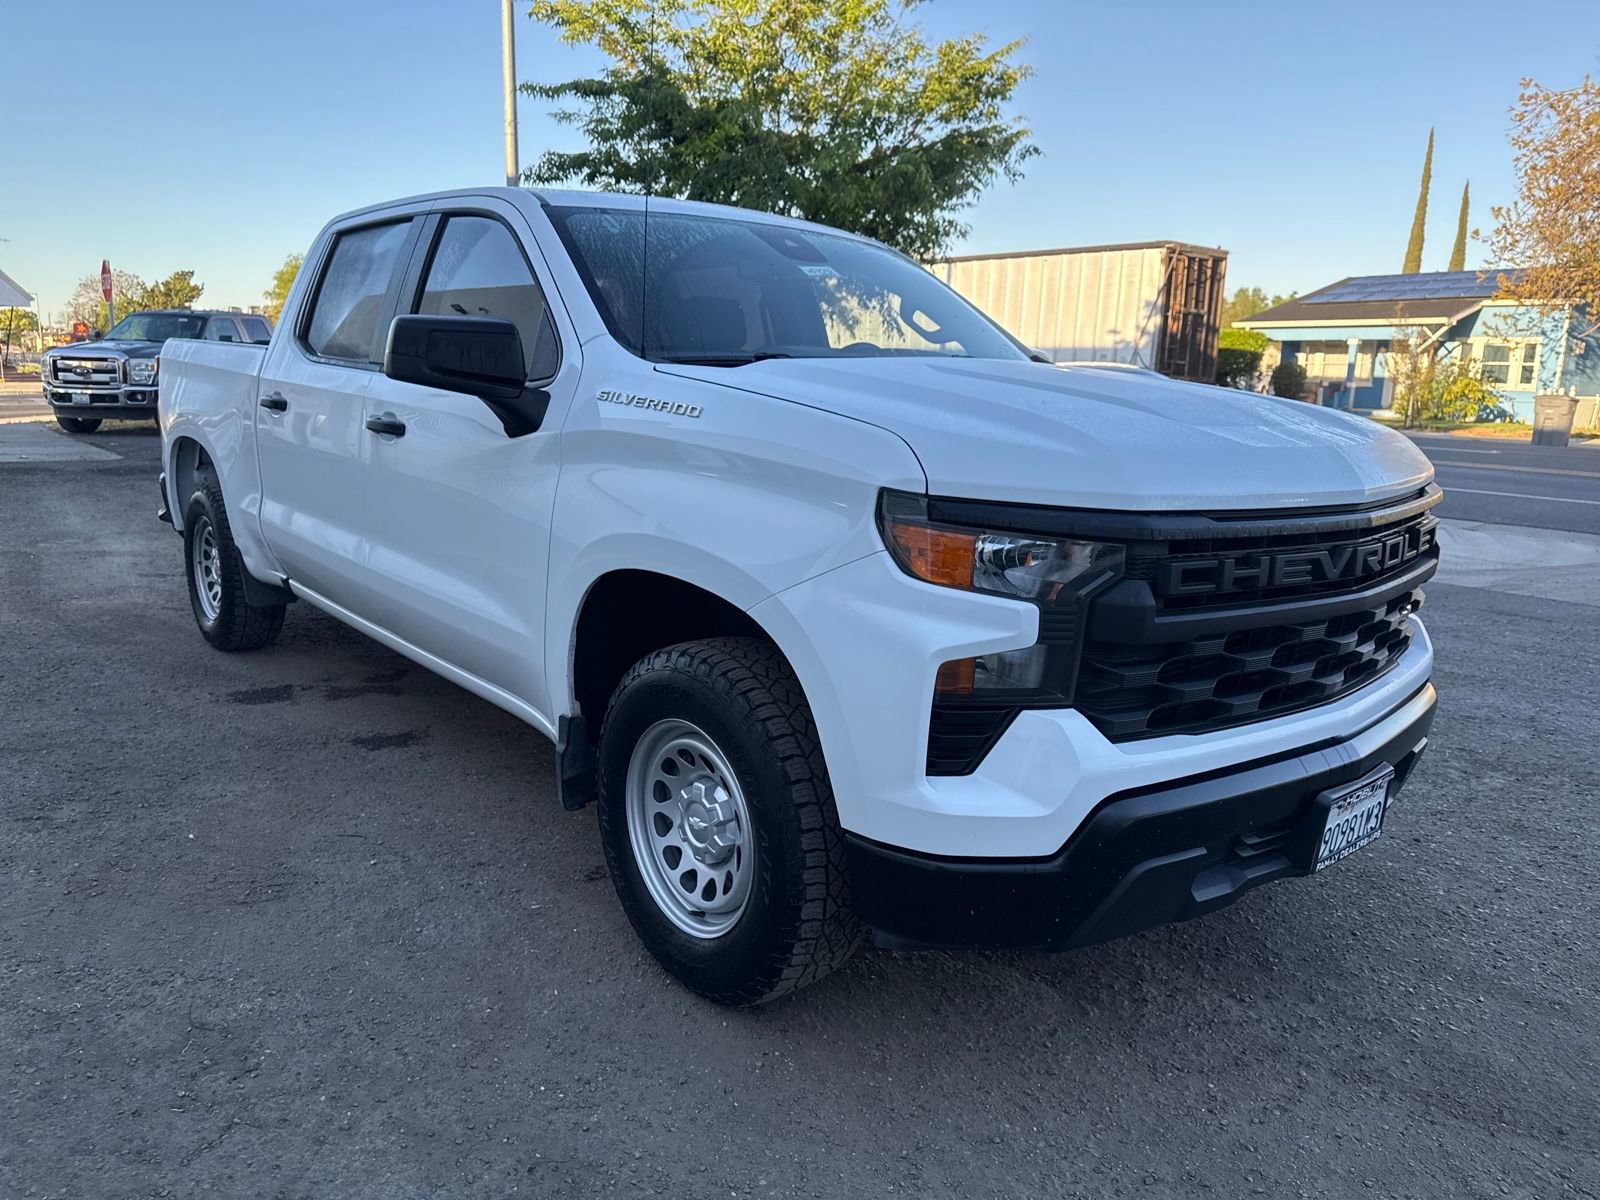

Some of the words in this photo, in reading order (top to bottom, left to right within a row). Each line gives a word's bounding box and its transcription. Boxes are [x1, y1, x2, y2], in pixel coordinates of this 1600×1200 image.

[597, 391, 703, 418] SILVERADO
[1316, 853, 1339, 872] FAMILY
[1340, 829, 1381, 859] DEALERSHIPS
